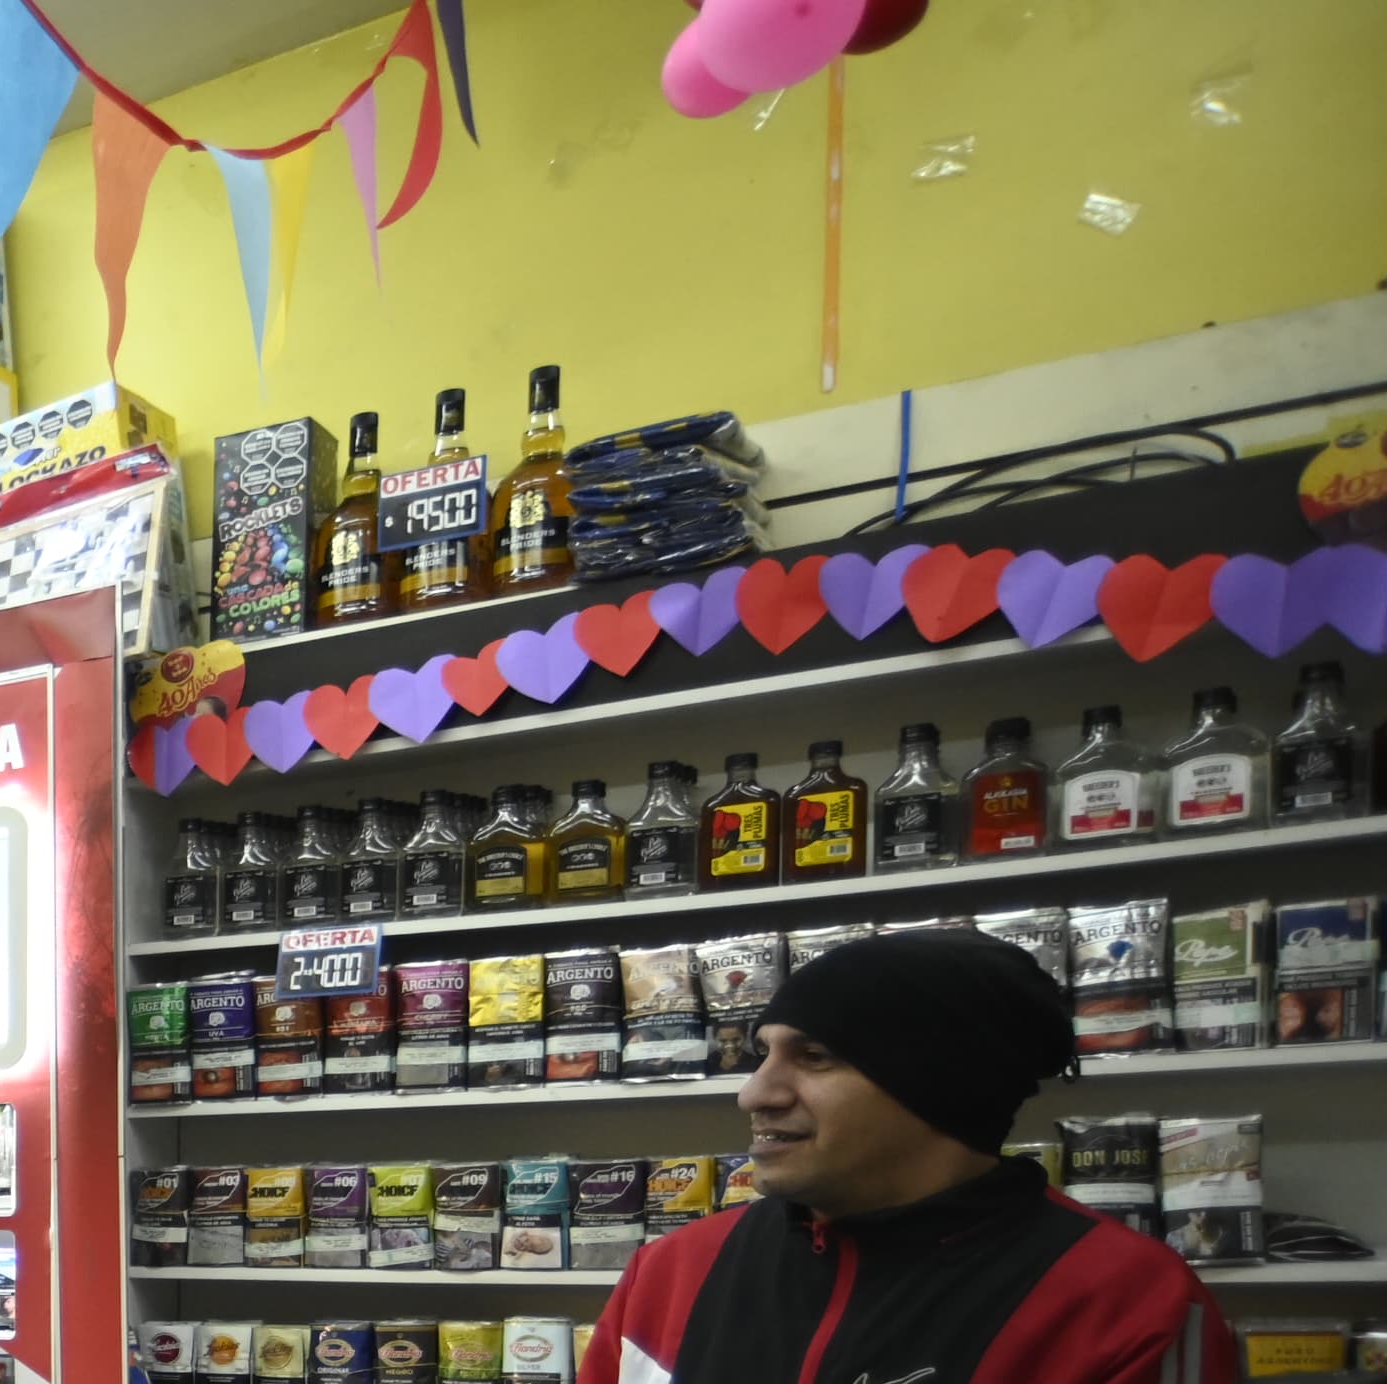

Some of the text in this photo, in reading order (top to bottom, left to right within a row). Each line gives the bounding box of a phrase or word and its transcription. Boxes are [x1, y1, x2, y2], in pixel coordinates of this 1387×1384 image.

[382, 458, 481, 495] OFERTA
[219, 498, 303, 542] ROCKLETS
[406, 490, 477, 534] 19500
[405, 547, 457, 566] BLENDERS
[321, 565, 370, 583] BLENDERS
[328, 574, 357, 586] PRIDE
[229, 590, 301, 617] COLORES
[830, 799, 840, 831] TRES
[839, 791, 852, 831] PLUMAS
[743, 813, 753, 840] TRES
[753, 804, 767, 840] PLUMAS
[284, 929, 375, 949] OFERTA
[1072, 918, 1163, 950] ARGENTO
[702, 947, 774, 972] ARGENTO
[1175, 937, 1236, 967] Pepe
[401, 977, 464, 993] ARGENTO
[547, 967, 614, 984] ARGENTO
[190, 996, 245, 1011] ARGENTO
[334, 1176, 357, 1188] #06
[462, 1174, 488, 1185] #09
[534, 1173, 558, 1184] #15
[609, 1171, 635, 1183] #16
[670, 1167, 697, 1179] #24
